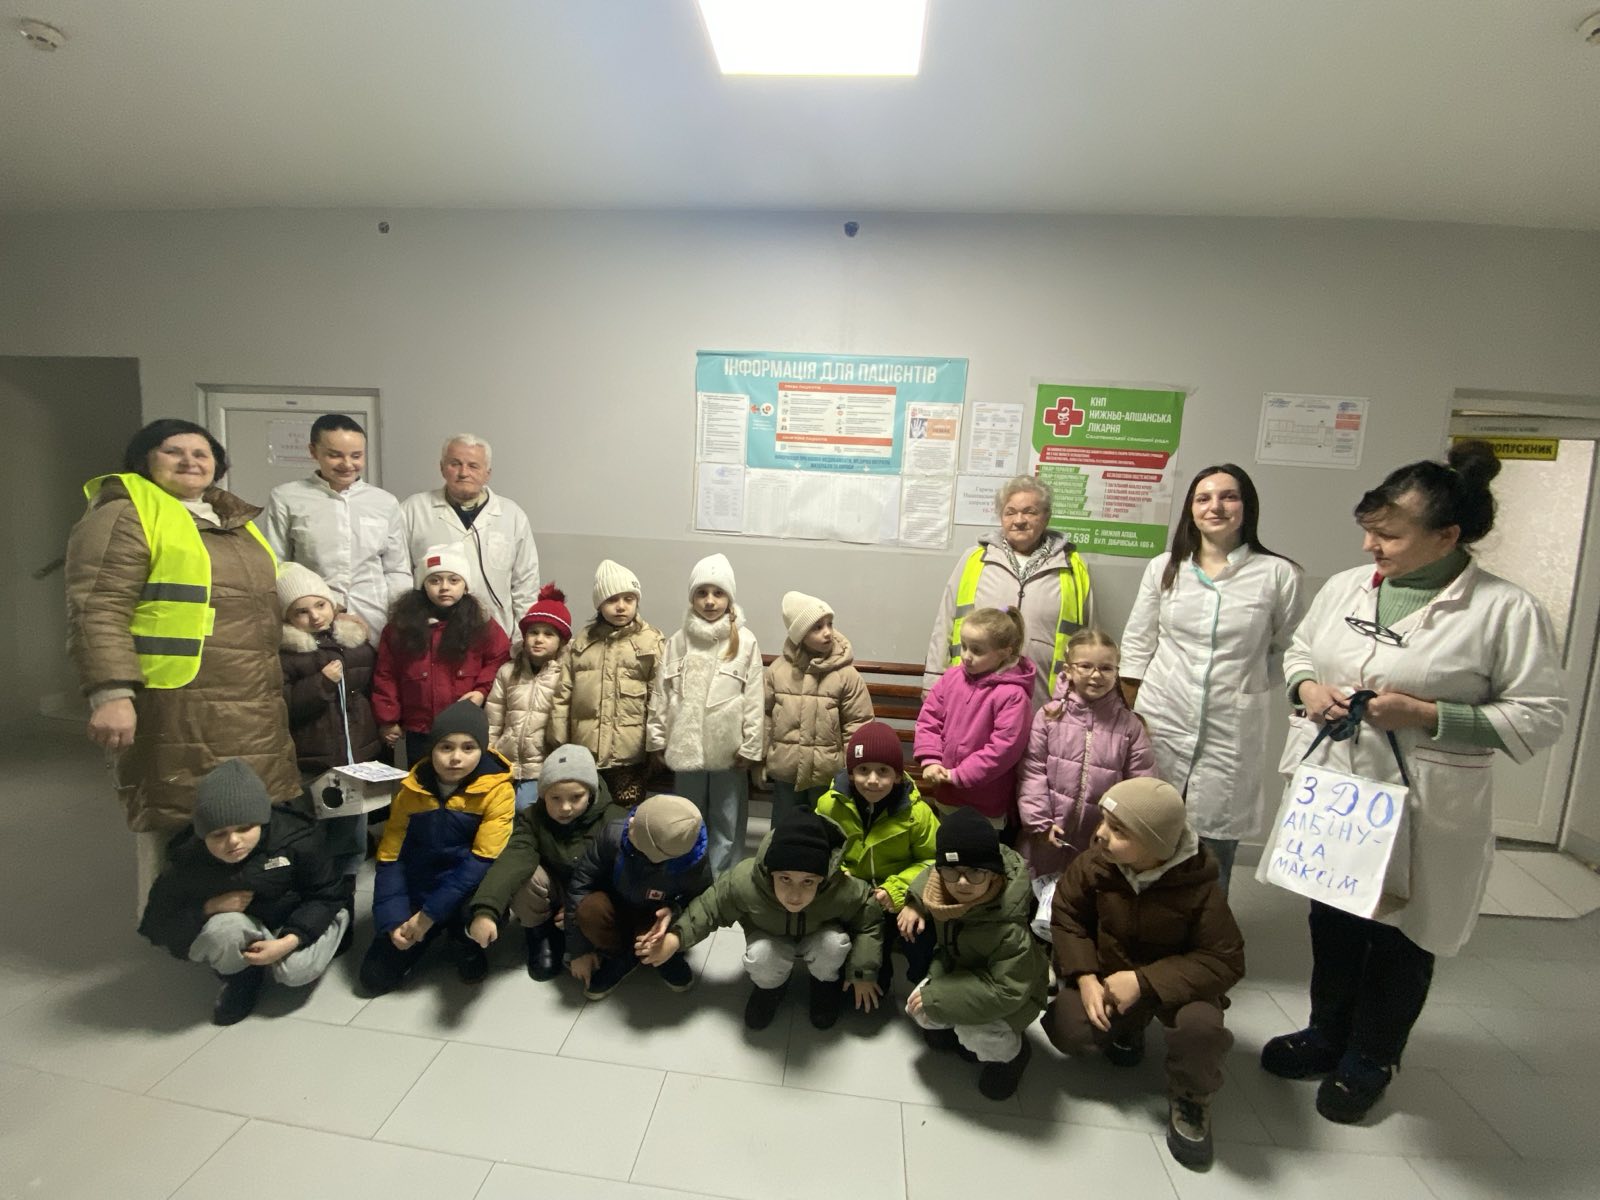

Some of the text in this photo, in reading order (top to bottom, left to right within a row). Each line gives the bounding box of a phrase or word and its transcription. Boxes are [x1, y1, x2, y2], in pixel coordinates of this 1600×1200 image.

[724, 358, 938, 384] ІНФОРМАЦІЯ ДЛЯ ПАЦІЄНТІВ
[1090, 397, 1106, 407] КНП
[1089, 409, 1172, 424] НИЖНЬО-АПШАНСЬКА
[1087, 422, 1121, 433] ЛІКАРНЯ
[1073, 533, 1090, 544] 538
